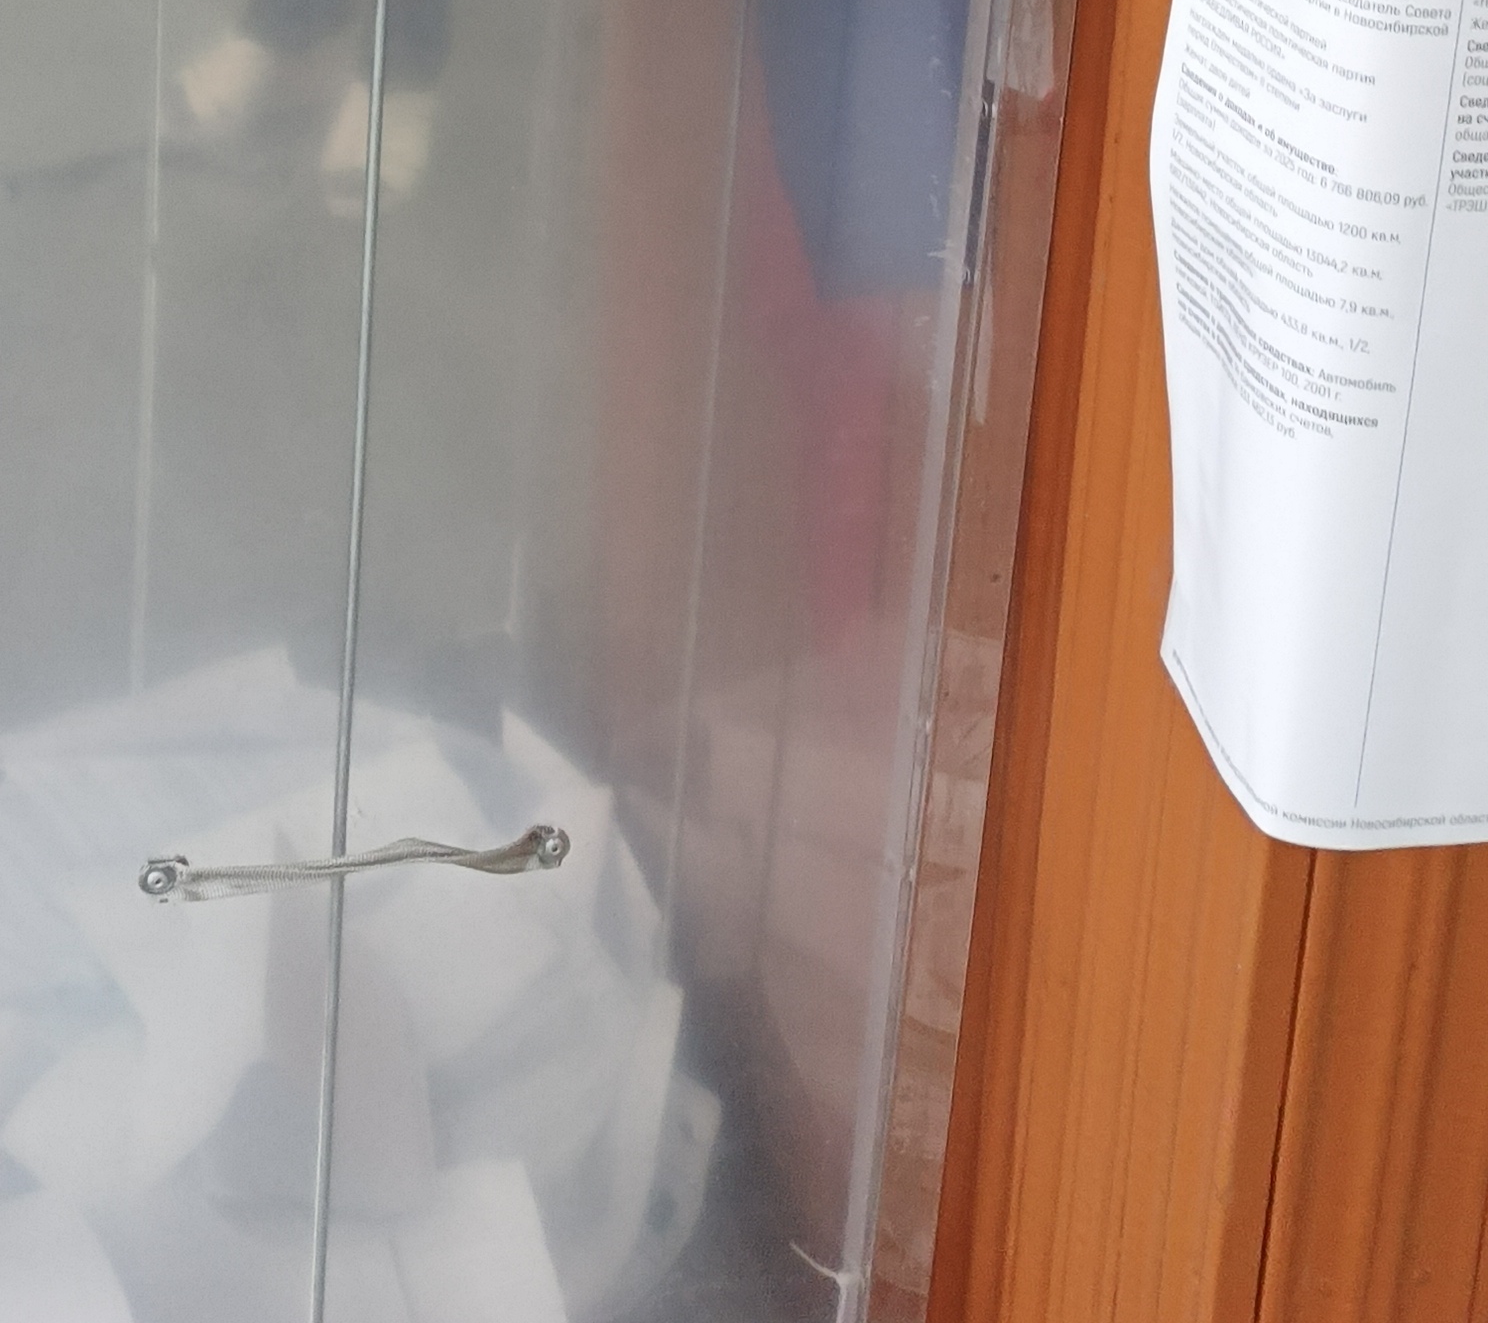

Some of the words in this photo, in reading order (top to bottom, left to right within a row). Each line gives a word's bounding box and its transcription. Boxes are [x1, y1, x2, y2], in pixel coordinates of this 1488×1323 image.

[1344, 8, 1449, 37] Новосибирской
[1405, 4, 1452, 20] Совета
[1332, 63, 1375, 85] партия
[1318, 97, 1368, 123] заслуги
[1277, 194, 1335, 231] площадью
[1338, 221, 1367, 240] 1200
[1272, 247, 1313, 277] область
[1275, 272, 1336, 309] площадью
[1303, 379, 1331, 398] 2001
[1318, 368, 1397, 393] Автомобиль
[1291, 397, 1378, 428] находящихся
